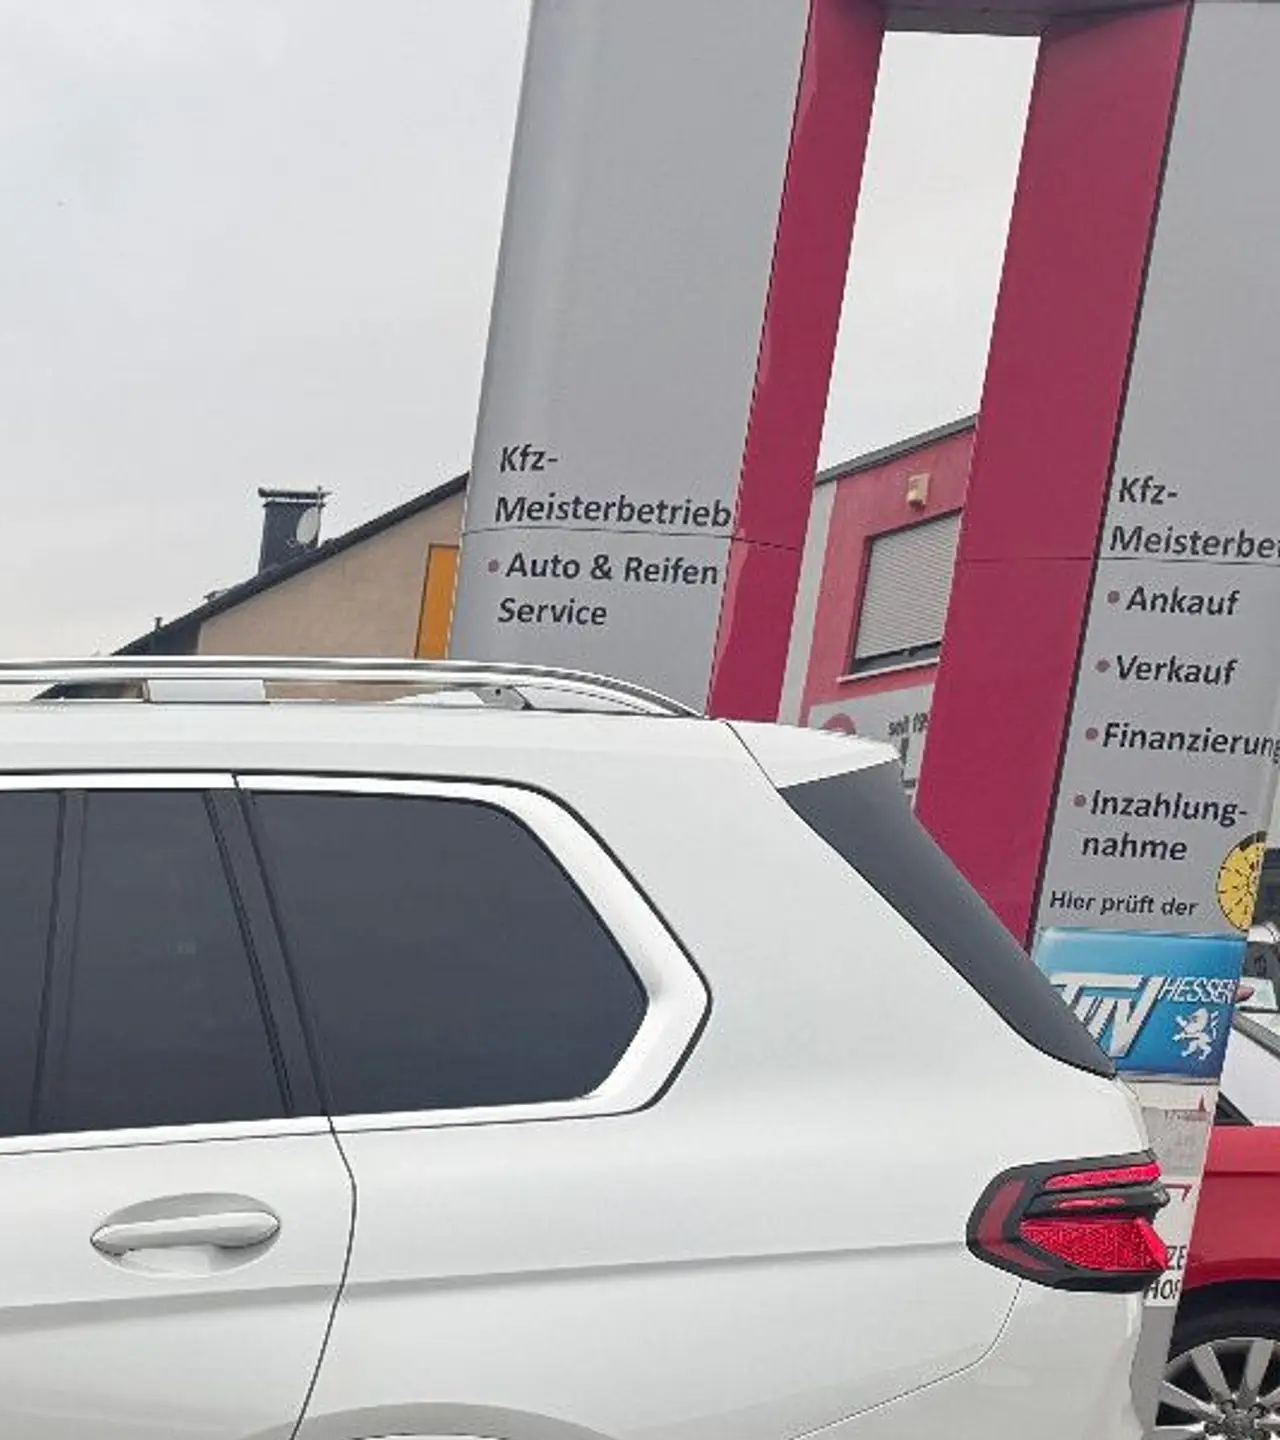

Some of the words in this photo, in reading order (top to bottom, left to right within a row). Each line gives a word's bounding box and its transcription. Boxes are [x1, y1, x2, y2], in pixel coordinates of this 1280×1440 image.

[500, 444, 558, 473] Kfz-
[1119, 475, 1178, 505] Kfz-
[495, 492, 732, 527] Meisterbetrieb
[505, 552, 581, 578] Auto
[589, 554, 613, 580] &
[624, 557, 718, 585] Reifen
[498, 597, 607, 625] Service
[1126, 586, 1240, 616] Ankauf
[1116, 655, 1238, 685] Verkauf
[1090, 789, 1247, 828] Inzahlung-
[1081, 832, 1188, 861] nahme
[1049, 890, 1096, 911] Hier
[1100, 894, 1155, 915] prüft
[1160, 897, 1200, 916] der
